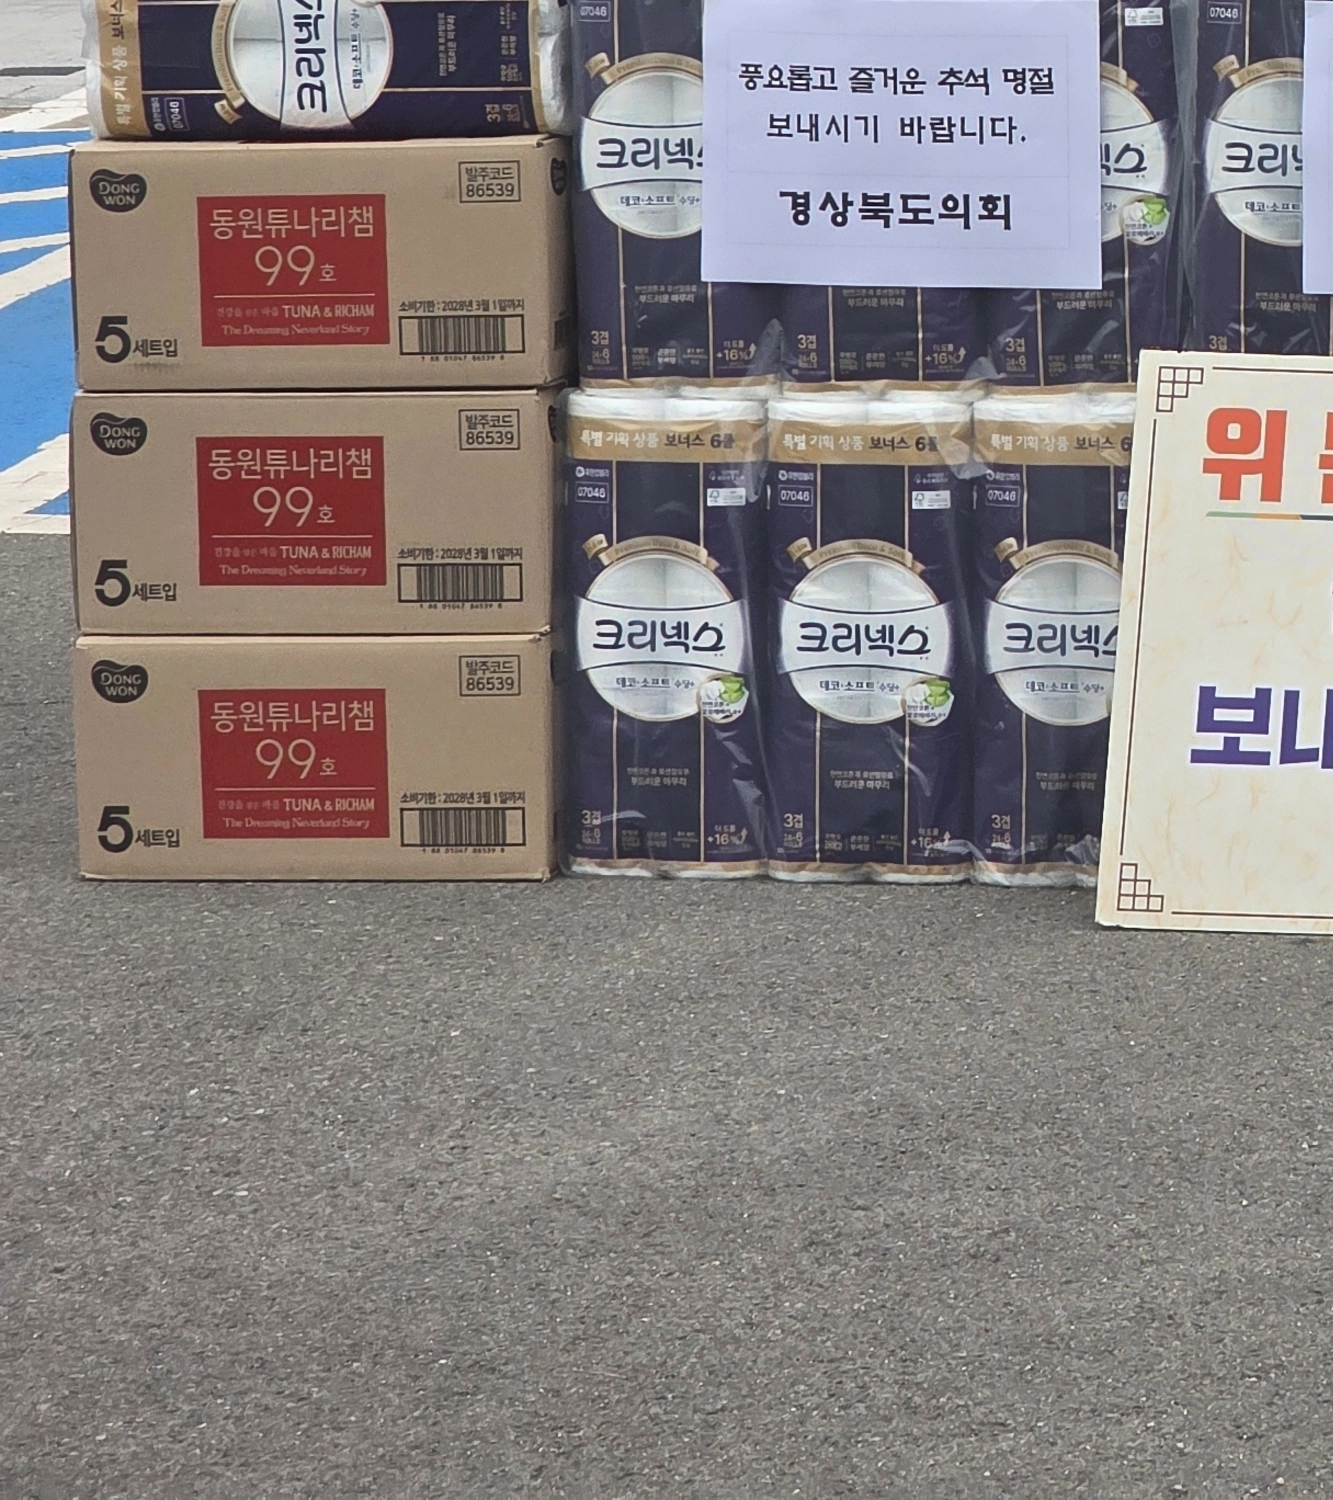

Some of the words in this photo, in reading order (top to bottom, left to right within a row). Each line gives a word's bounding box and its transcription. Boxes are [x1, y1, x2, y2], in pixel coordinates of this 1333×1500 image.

[738, 62, 838, 92] 풍요롭고
[848, 65, 927, 95] 즐거운
[937, 66, 990, 96] 추석
[1002, 66, 1055, 96] 명절
[766, 113, 879, 144] 보내시기
[899, 115, 1026, 145] 바랍니다.
[596, 137, 703, 170] 크리넥
[465, 167, 515, 182] 발주코드
[98, 181, 140, 194] DONG
[465, 183, 515, 197] 86539
[102, 195, 136, 205] WON
[779, 191, 1012, 230] 경상북도의회
[209, 206, 374, 240] 동원튜나리챔
[282, 304, 321, 318] TUNA
[323, 306, 333, 317] &
[334, 304, 375, 317] RICHAM
[465, 413, 514, 430] 발주코드
[99, 424, 141, 438] DONG
[465, 430, 515, 446] 86539
[103, 438, 137, 449] WON
[208, 448, 373, 480] 동원튜나리챔
[280, 545, 319, 559] TUNA
[321, 546, 331, 559] &
[332, 545, 372, 559] RICHAM
[592, 619, 727, 656] 크리넥스
[796, 621, 931, 658] 크리넥스
[466, 659, 515, 676] 발주코드
[101, 672, 142, 686] DONG
[466, 676, 516, 692] 86539
[105, 686, 138, 697] WON
[210, 700, 375, 733] 동원튜나리챔
[283, 798, 322, 811] TUNA
[324, 799, 333, 811] &
[335, 797, 375, 811] RICHAM
